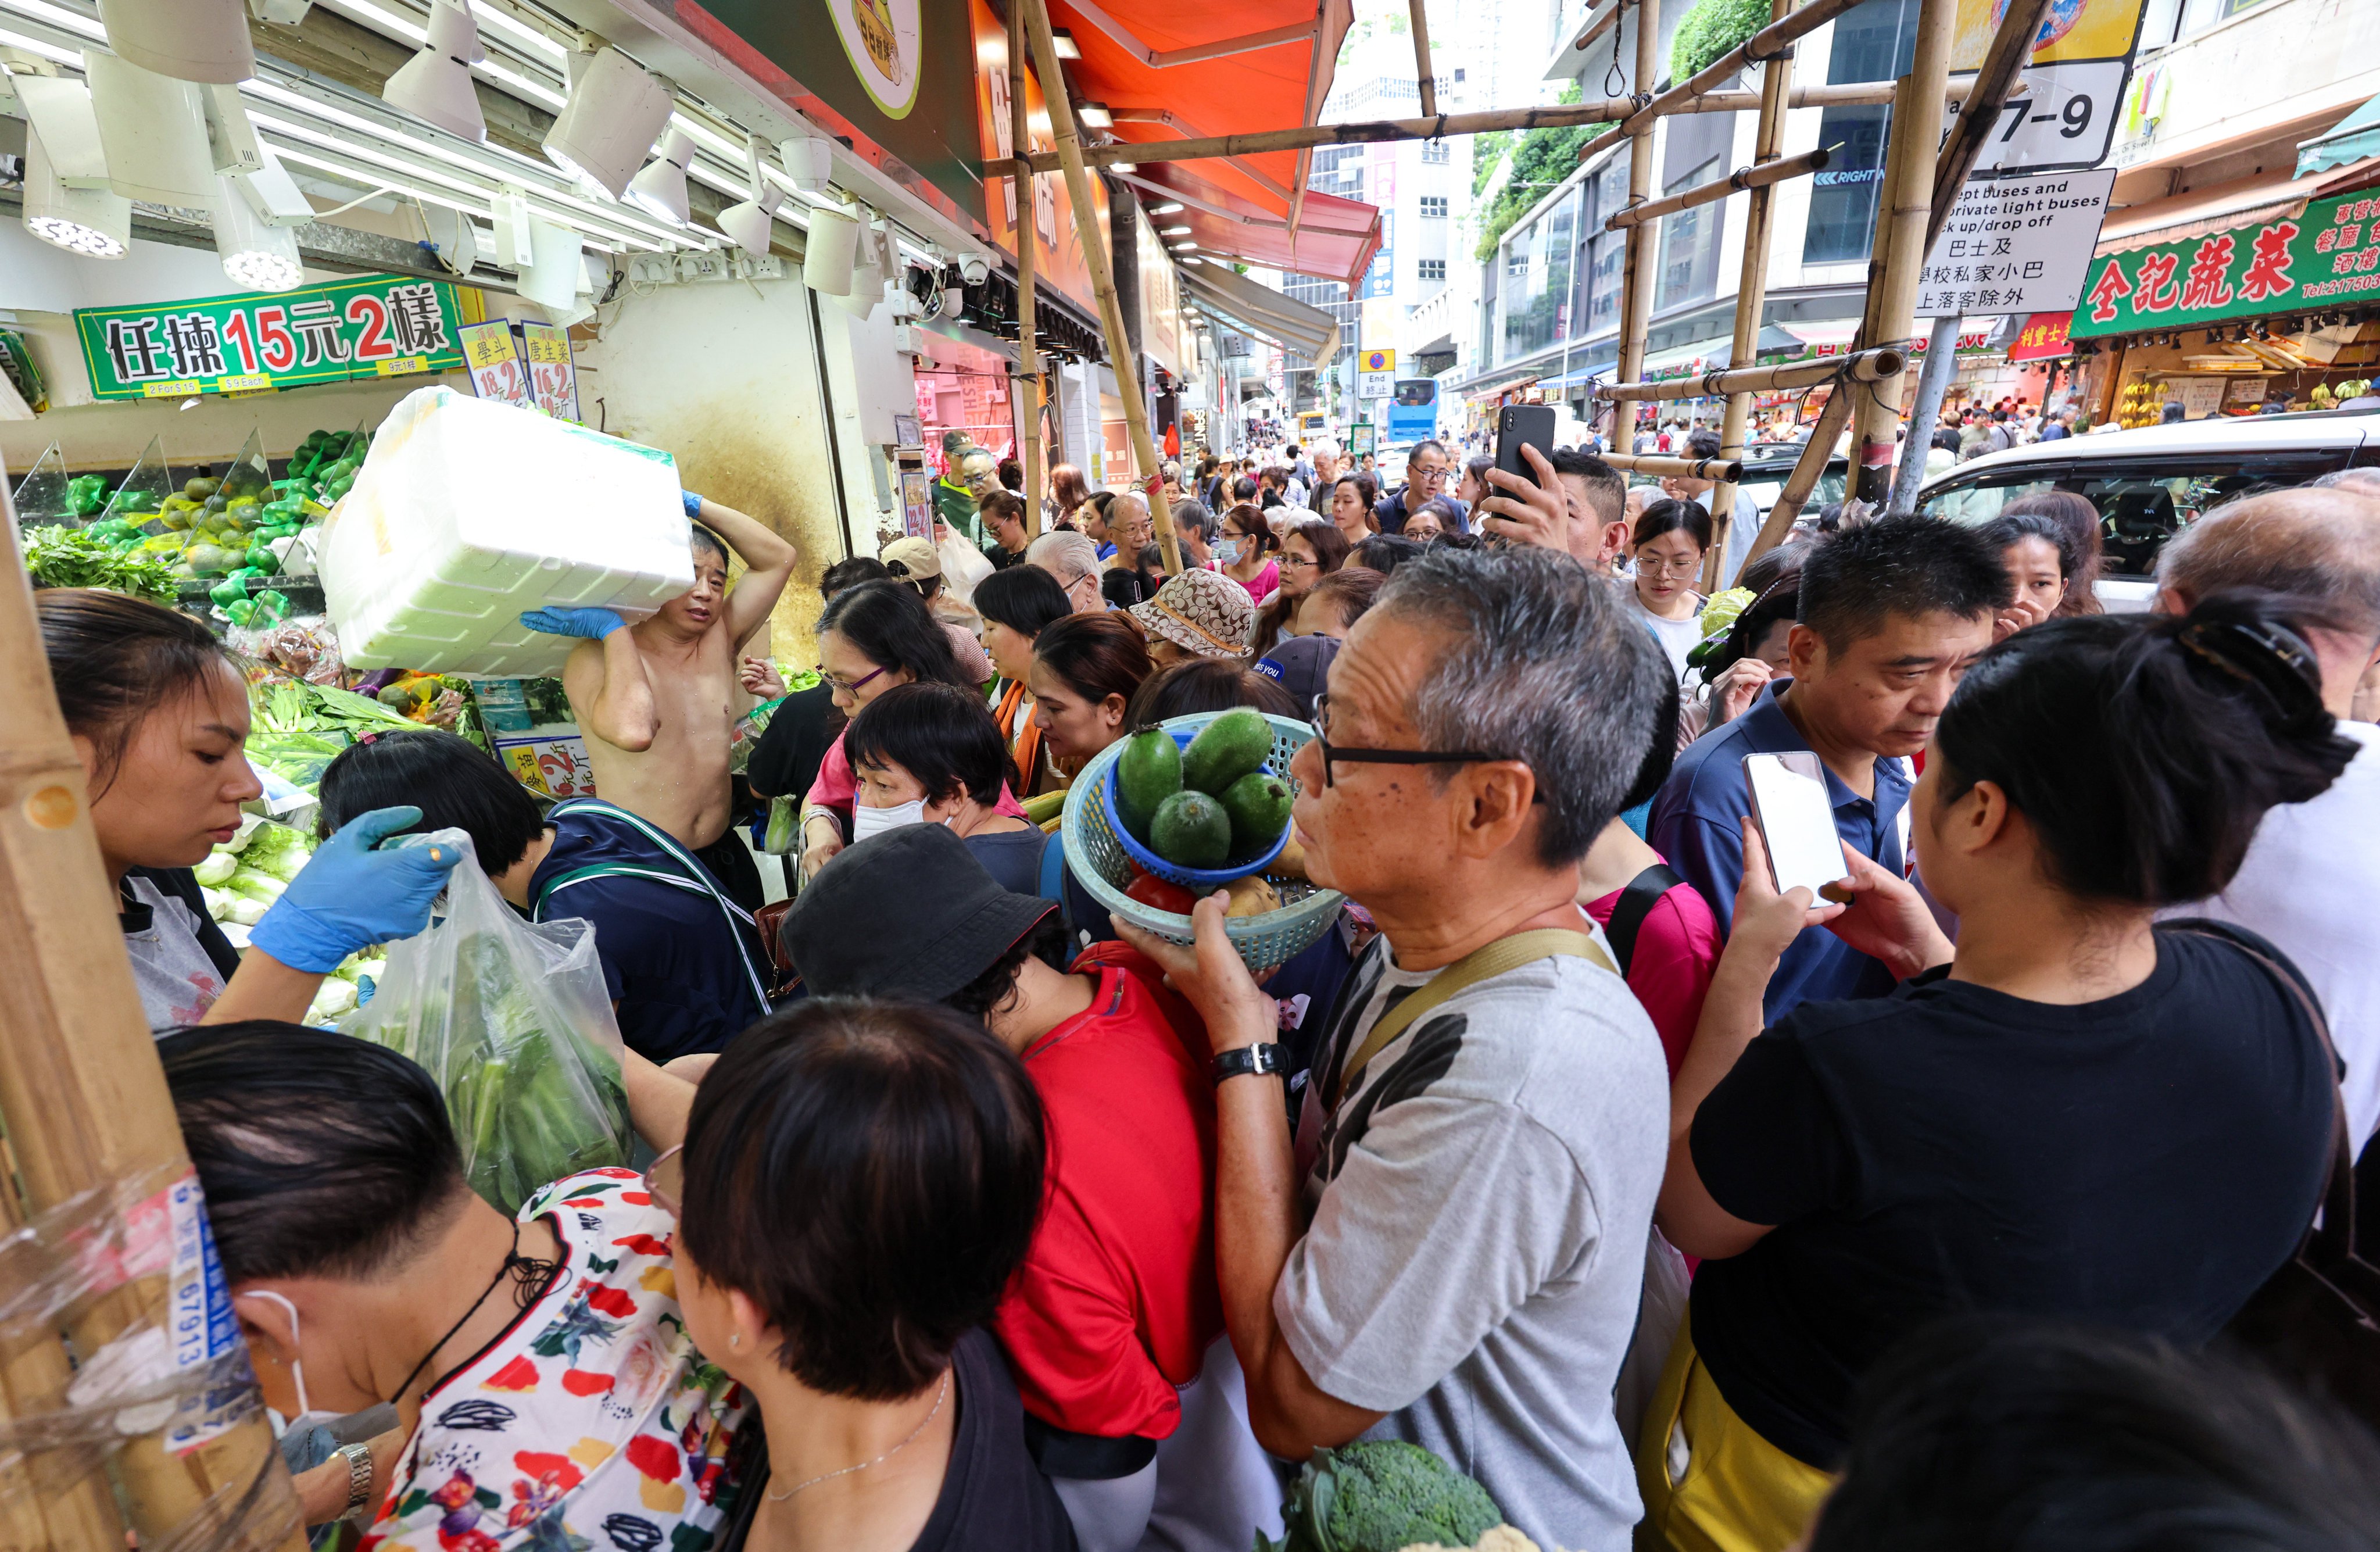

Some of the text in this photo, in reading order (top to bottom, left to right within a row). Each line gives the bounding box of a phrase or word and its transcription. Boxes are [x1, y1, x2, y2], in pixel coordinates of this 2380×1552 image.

[2132, 139, 2150, 150] Street
[1837, 169, 1876, 184] RIGHT
[1982, 185, 2030, 200] buses
[2035, 180, 2069, 195] and
[2002, 200, 2042, 215] light
[2048, 196, 2100, 209] buses
[1960, 219, 2022, 234] up/drop
[2028, 214, 2054, 228] off
[1948, 237, 2012, 258] 巴士及
[2332, 246, 2379, 274] 酒樓
[2088, 223, 2299, 323] 全記蔬菜
[1917, 287, 2024, 310] 上落客除外
[108, 285, 447, 381] 任揀15元2樣
[529, 339, 570, 362] 唐生菜
[388, 359, 417, 372] 9元1样
[234, 378, 239, 387] 9
[241, 377, 264, 387] Each
[1369, 374, 1386, 382] End
[149, 385, 156, 394] 2
[158, 385, 173, 394] For
[184, 382, 195, 391] 15
[1366, 385, 1387, 395] 終止
[1194, 409, 1207, 444] SAINT
[1261, 665, 1279, 678] you
